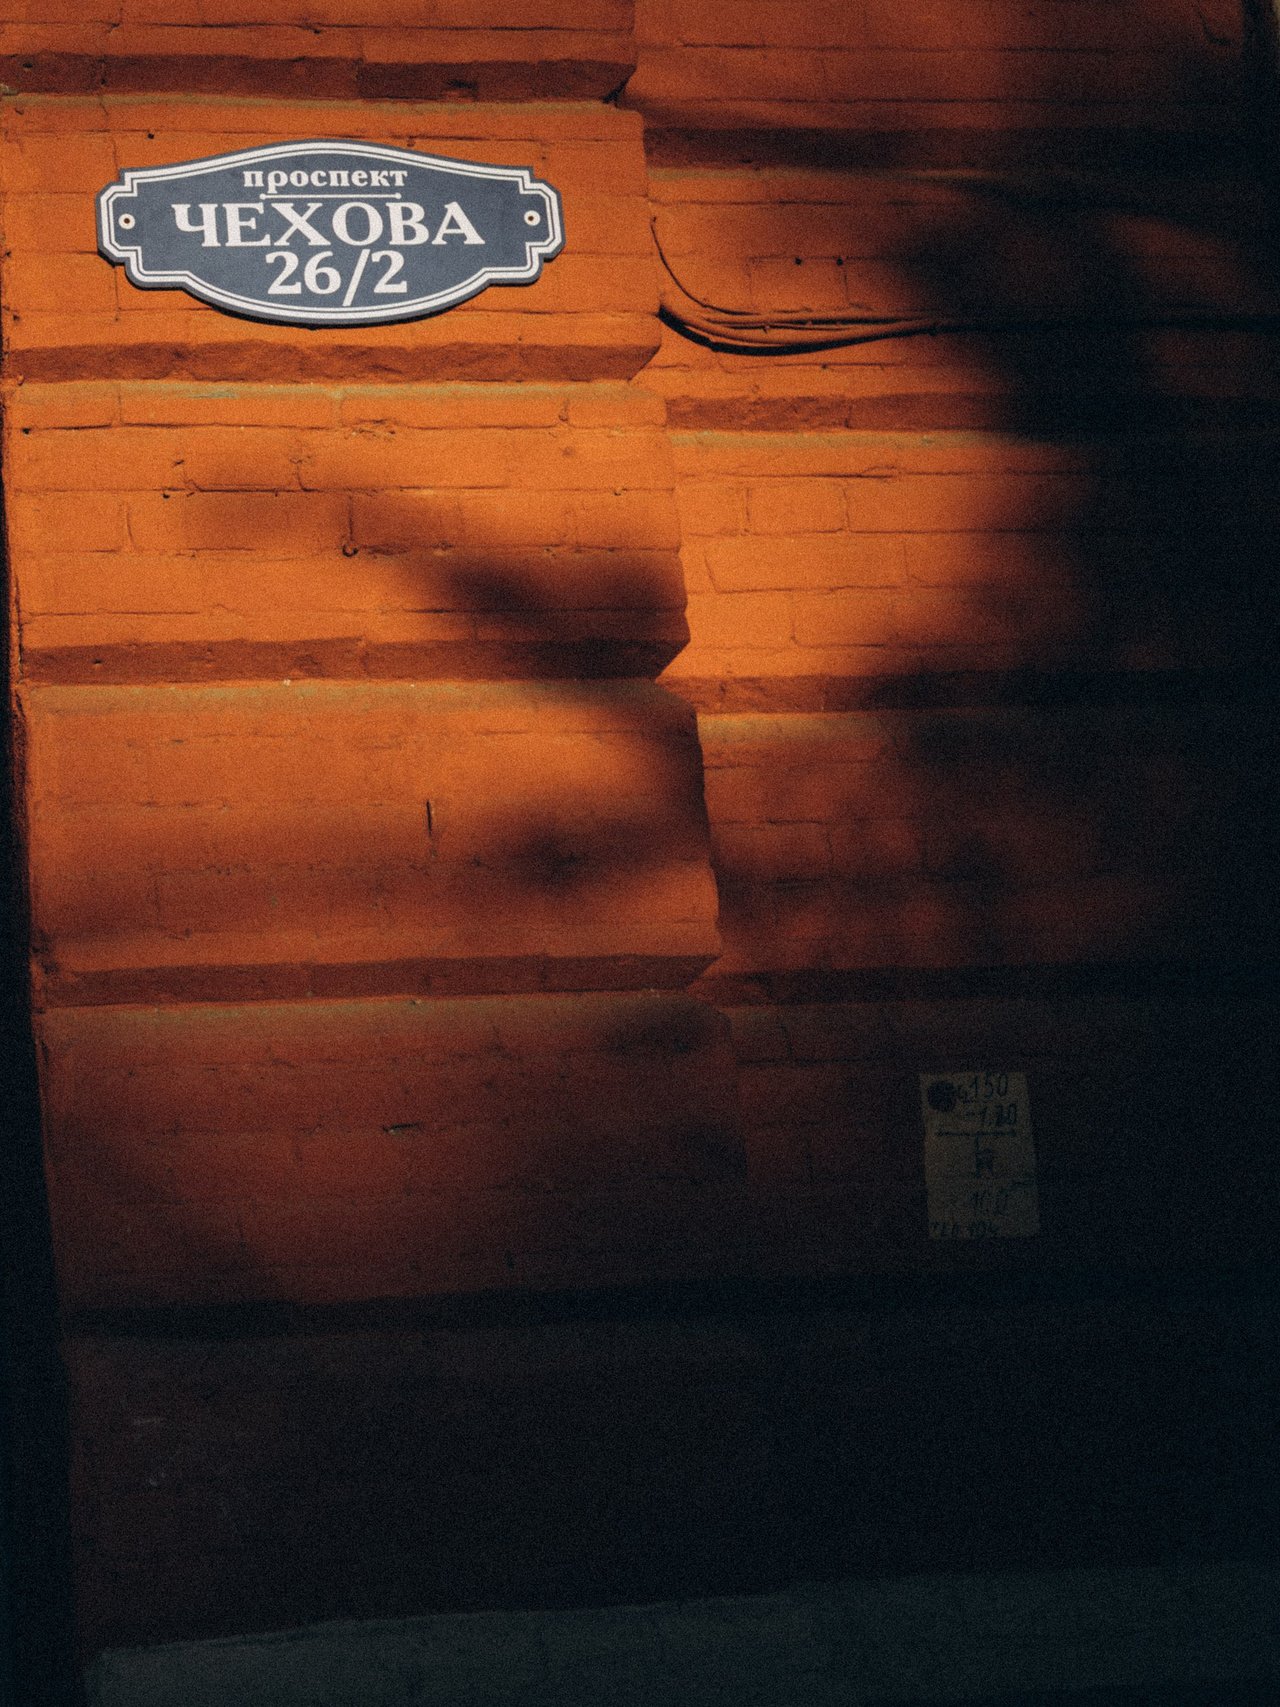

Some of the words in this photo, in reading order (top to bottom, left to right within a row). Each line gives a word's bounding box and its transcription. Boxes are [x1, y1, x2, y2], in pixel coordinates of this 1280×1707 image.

[243, 170, 408, 193] проспект
[172, 201, 486, 247] ЧЕХОВА
[265, 249, 408, 306] 26/2
